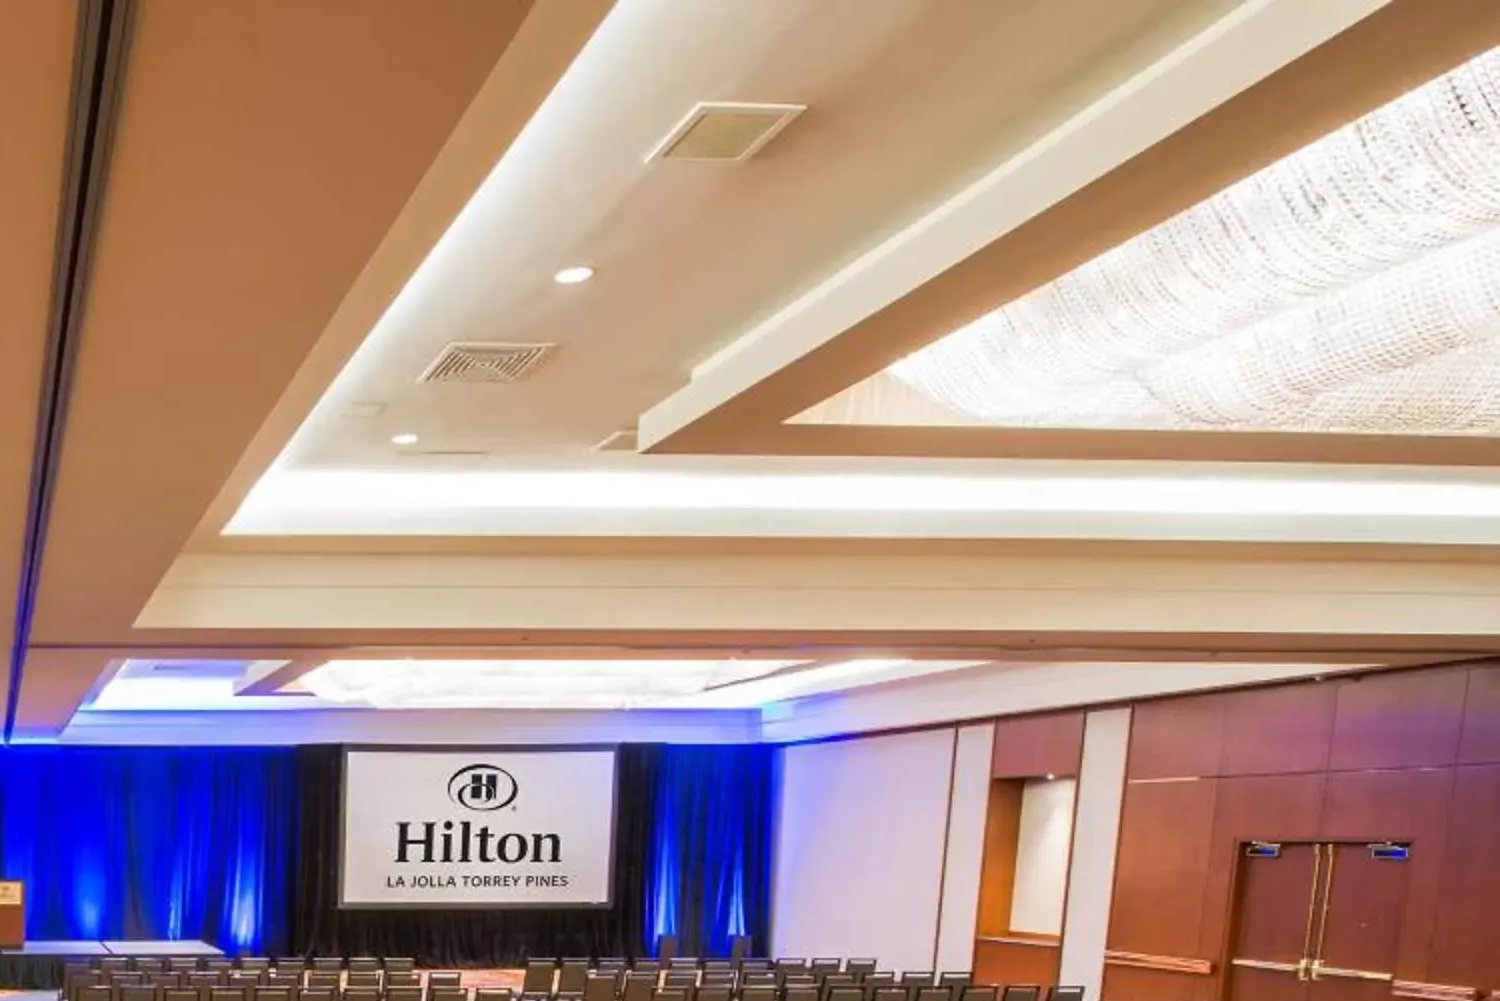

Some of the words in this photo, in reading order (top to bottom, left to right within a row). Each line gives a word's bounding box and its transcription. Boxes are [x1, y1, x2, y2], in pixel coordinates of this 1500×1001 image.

[394, 820, 563, 863] Hilton
[387, 876, 406, 888] LA
[410, 875, 457, 888] JOLLA
[462, 875, 521, 887] TORREY
[525, 875, 569, 887] PINES
